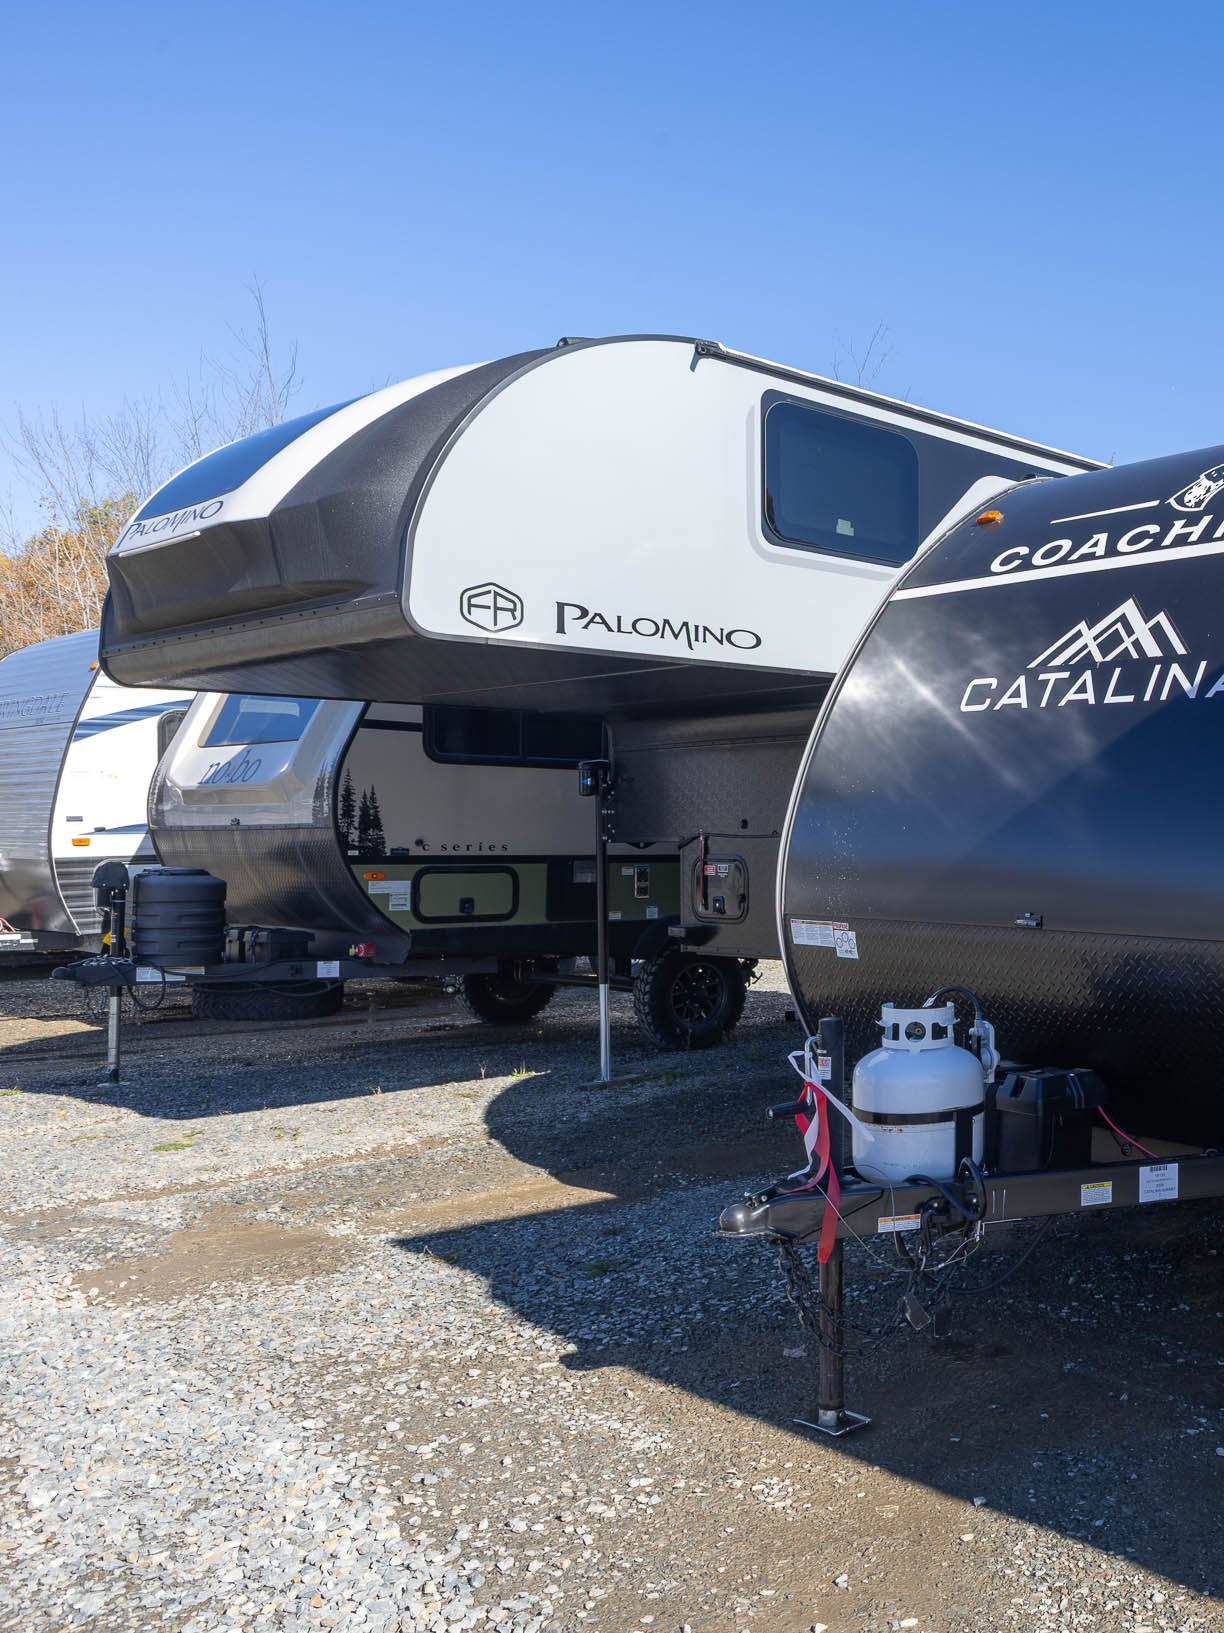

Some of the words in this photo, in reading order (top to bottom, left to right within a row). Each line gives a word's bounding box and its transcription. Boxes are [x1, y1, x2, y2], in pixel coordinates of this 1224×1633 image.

[117, 500, 224, 549] PALOMINO
[555, 600, 763, 651] PALOMINO
[440, 841, 509, 852] series
